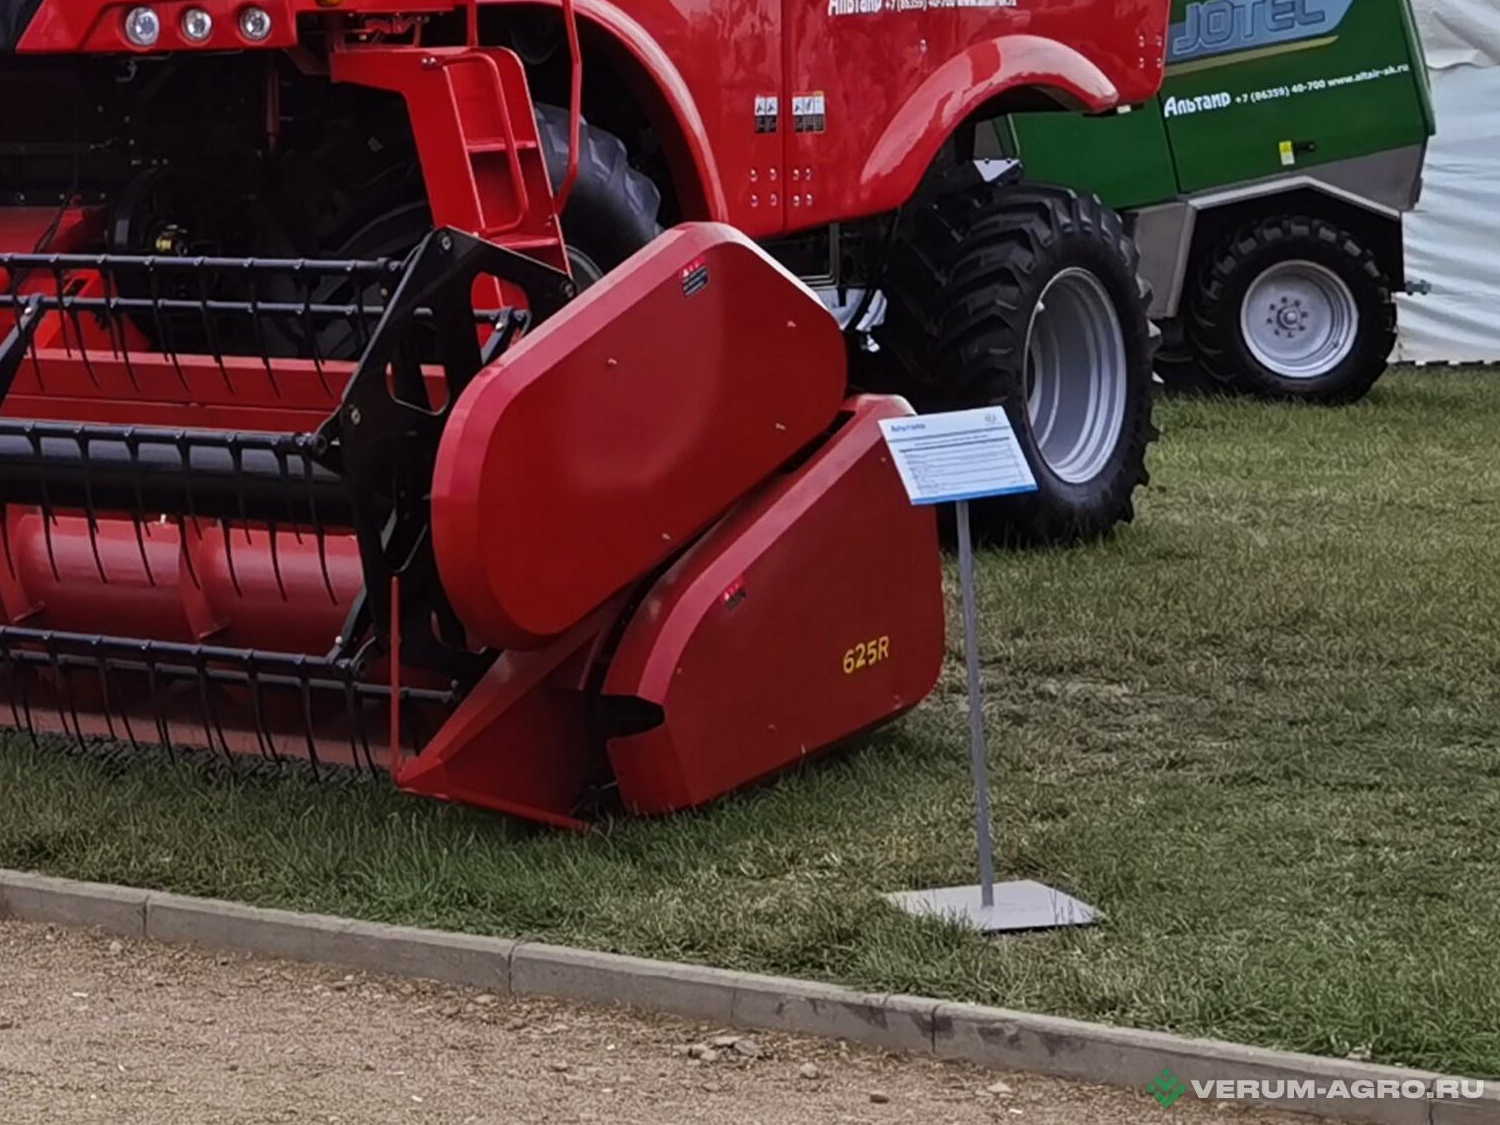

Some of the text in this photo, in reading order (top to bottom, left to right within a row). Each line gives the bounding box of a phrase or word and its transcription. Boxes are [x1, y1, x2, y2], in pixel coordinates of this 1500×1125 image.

[1164, 64, 1409, 117] Альтаир +7 (86359) 40-700 www.altair-ak.ru
[843, 635, 889, 674] 625R
